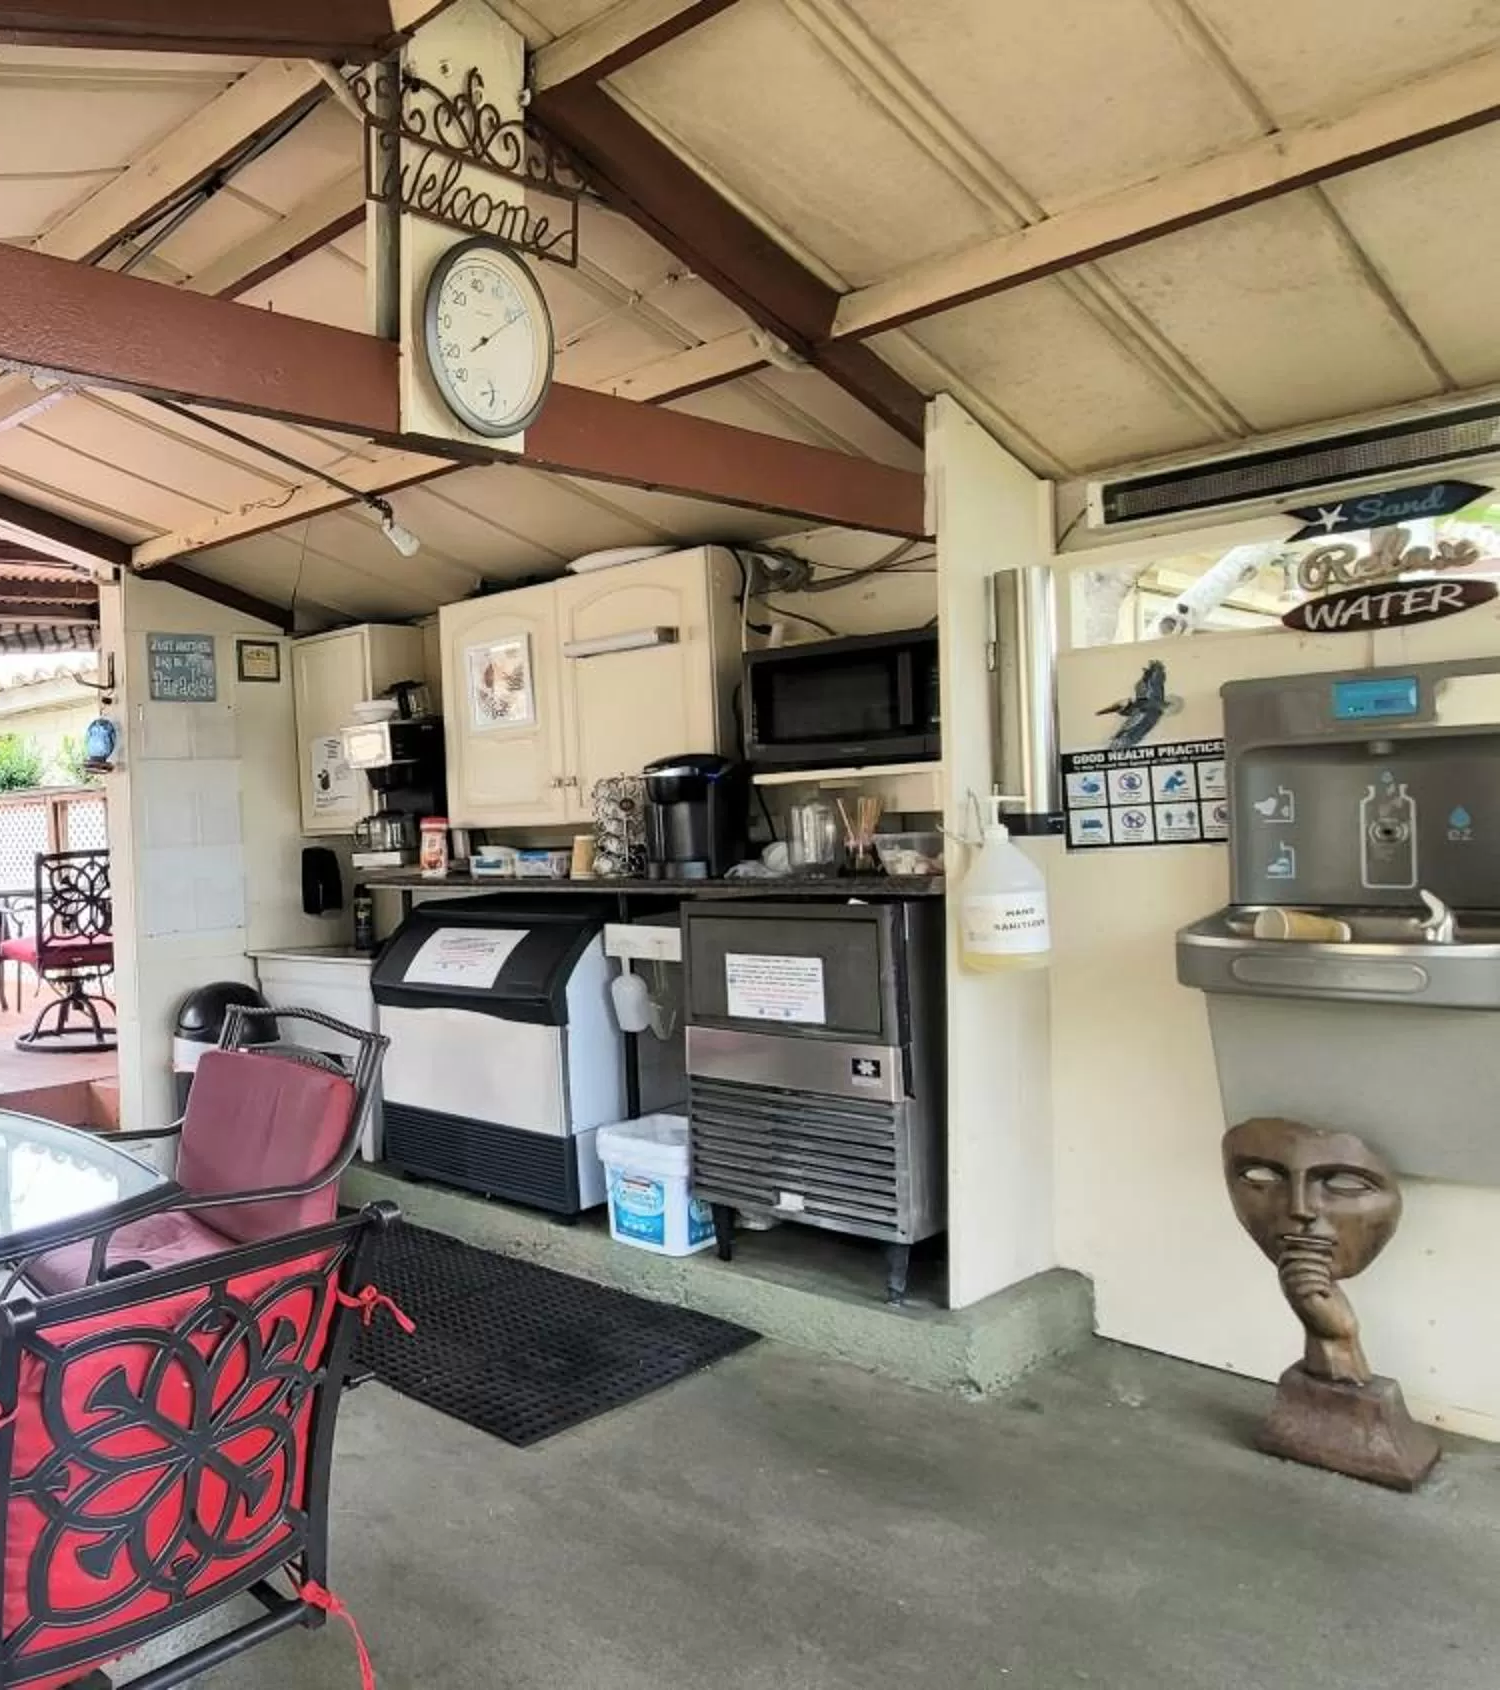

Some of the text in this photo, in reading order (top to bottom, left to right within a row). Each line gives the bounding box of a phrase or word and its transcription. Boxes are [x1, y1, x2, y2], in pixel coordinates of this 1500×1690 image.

[382, 148, 573, 250] Welcome
[452, 290, 467, 306] 20
[443, 314, 451, 329] 0
[1353, 485, 1446, 524] Sand
[1298, 526, 1480, 591] Relax
[1304, 582, 1465, 631] WATER
[1072, 752, 1105, 765] GOOD
[1107, 747, 1155, 762] HEALTH
